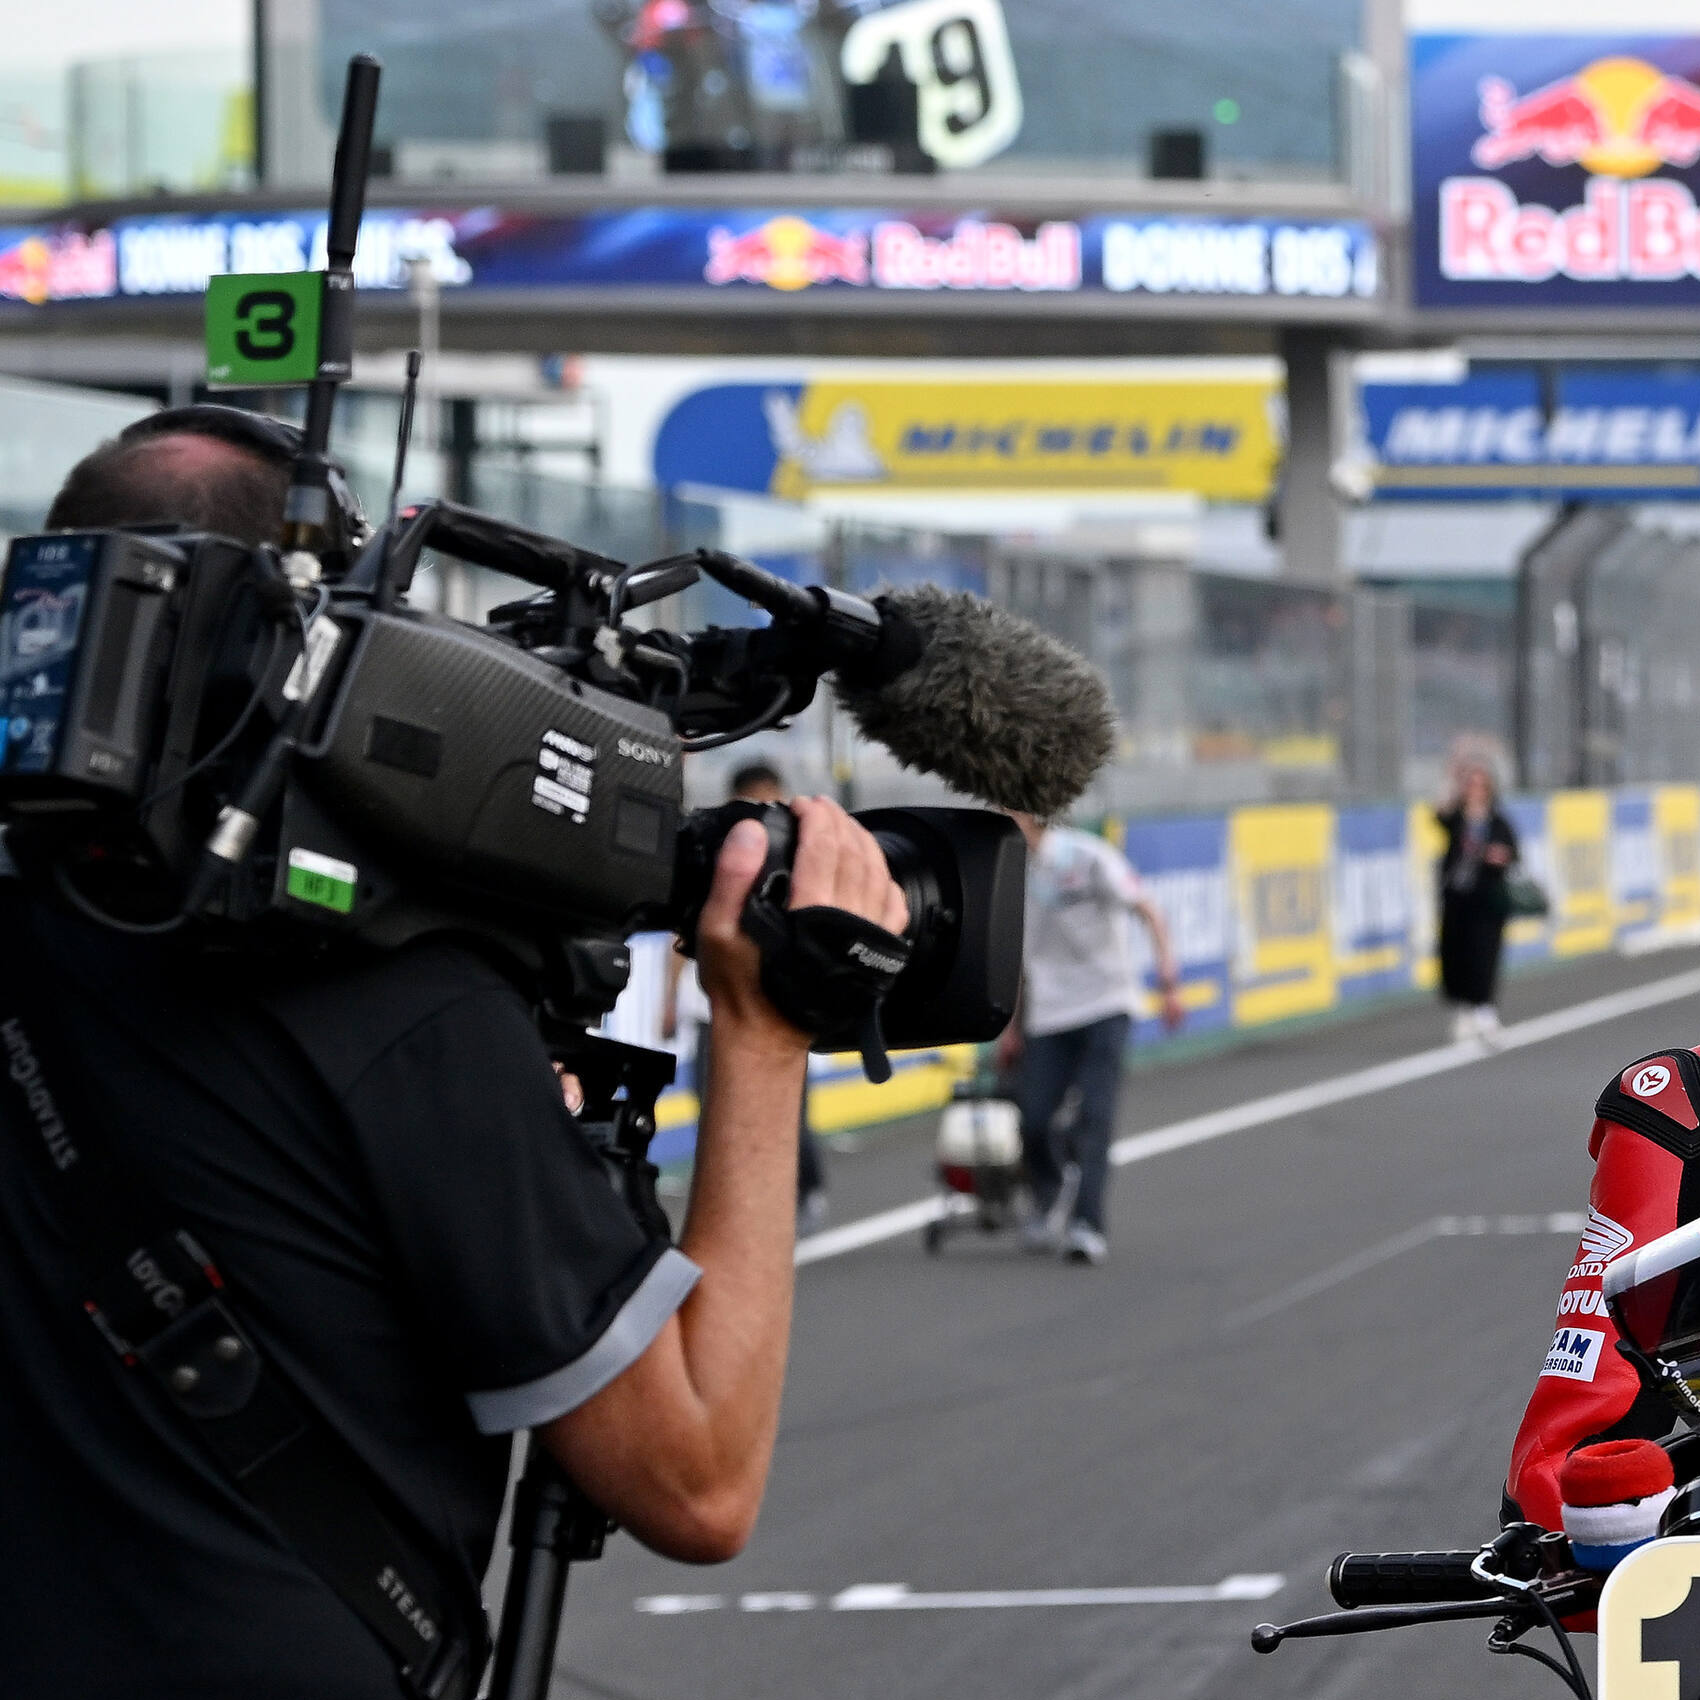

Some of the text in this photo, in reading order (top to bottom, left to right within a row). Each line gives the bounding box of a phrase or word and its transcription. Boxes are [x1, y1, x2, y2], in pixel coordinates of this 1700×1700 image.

[871, 221, 1082, 289] Red Bull
[1440, 177, 1621, 282] Red
[235, 290, 295, 361] 3
[895, 420, 1242, 458] MICHELIN
[616, 737, 674, 770] SONY
[1556, 1289, 1610, 1318] OTUL
